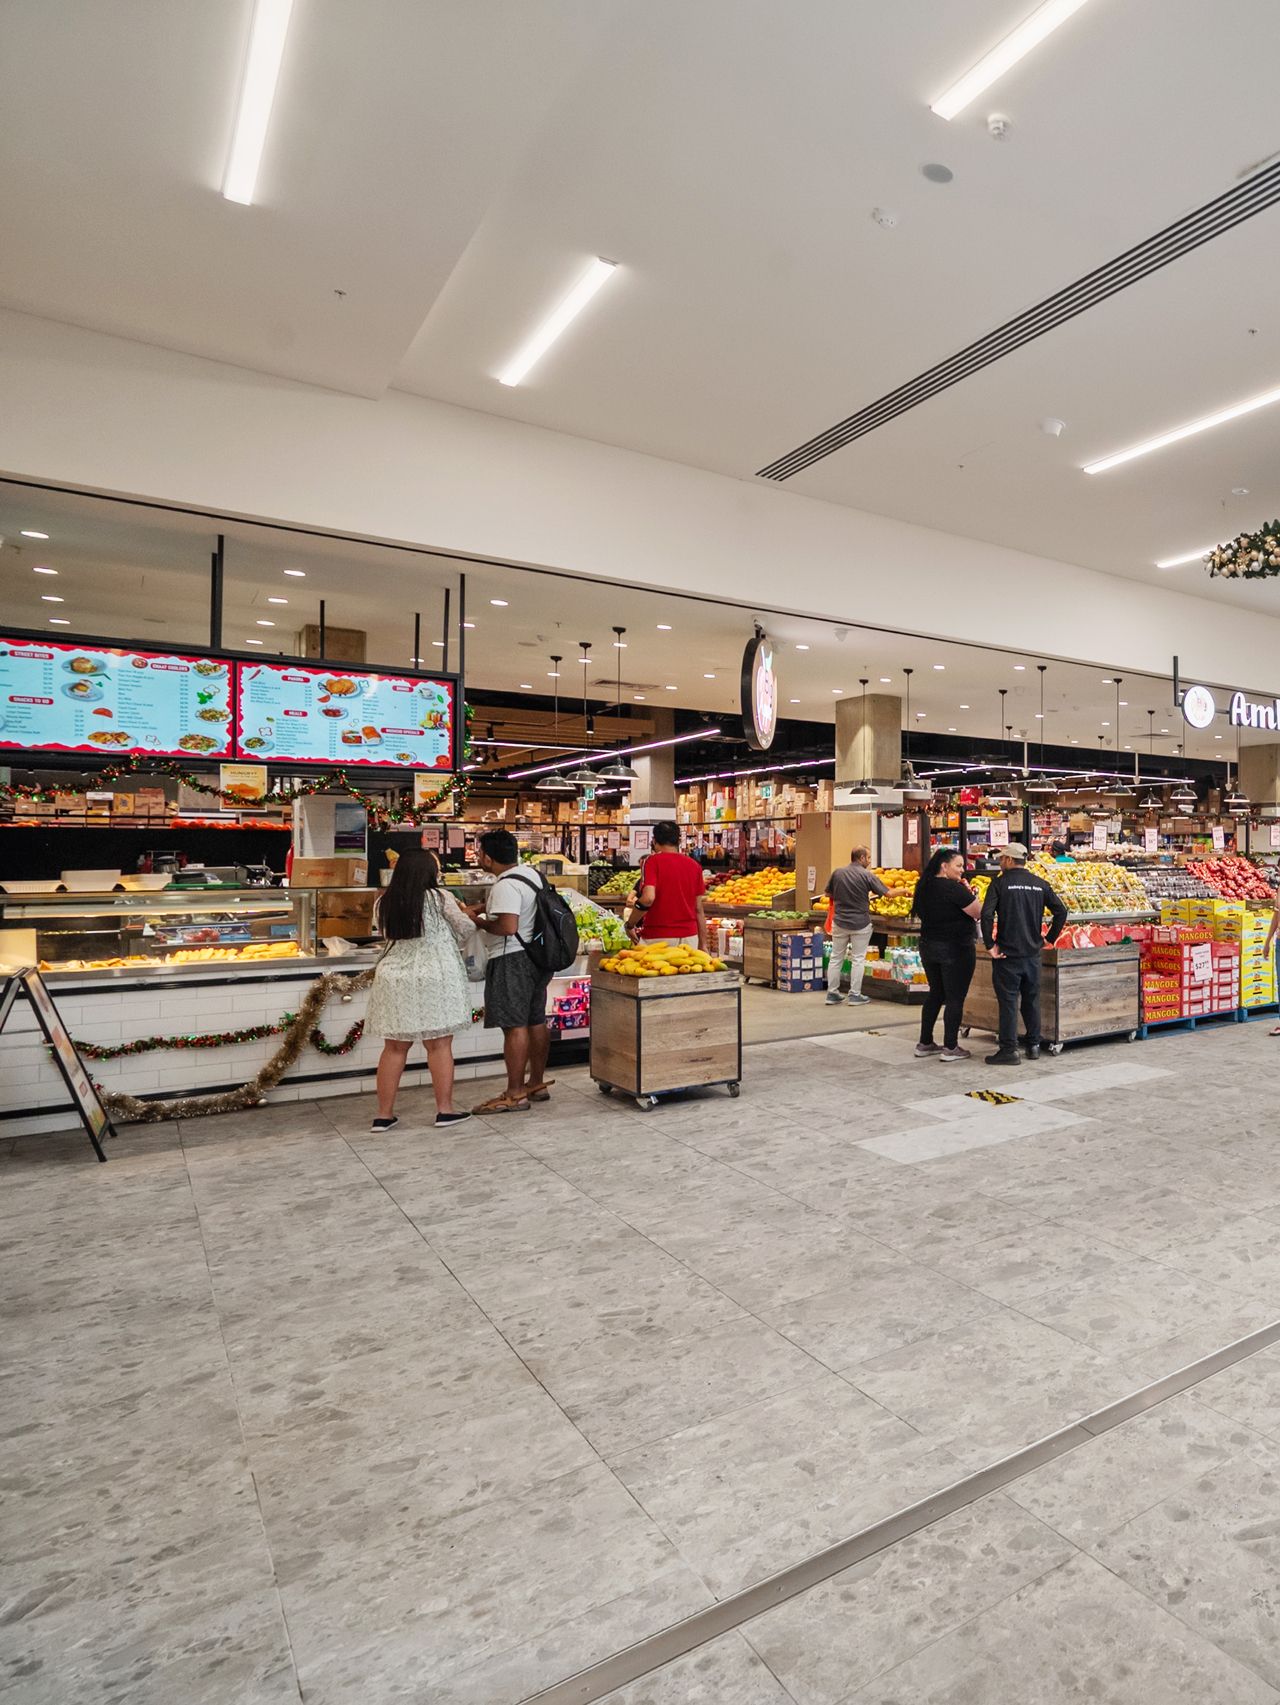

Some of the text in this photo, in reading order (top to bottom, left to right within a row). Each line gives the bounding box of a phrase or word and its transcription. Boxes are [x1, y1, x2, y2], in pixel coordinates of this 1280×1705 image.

[1179, 931, 1213, 941] MANGOES
[1152, 946, 1181, 956] MANGOES
[1144, 980, 1179, 989] MANGOES
[1145, 994, 1180, 1004] MANGOES
[1145, 1008, 1180, 1020] MANGOES
